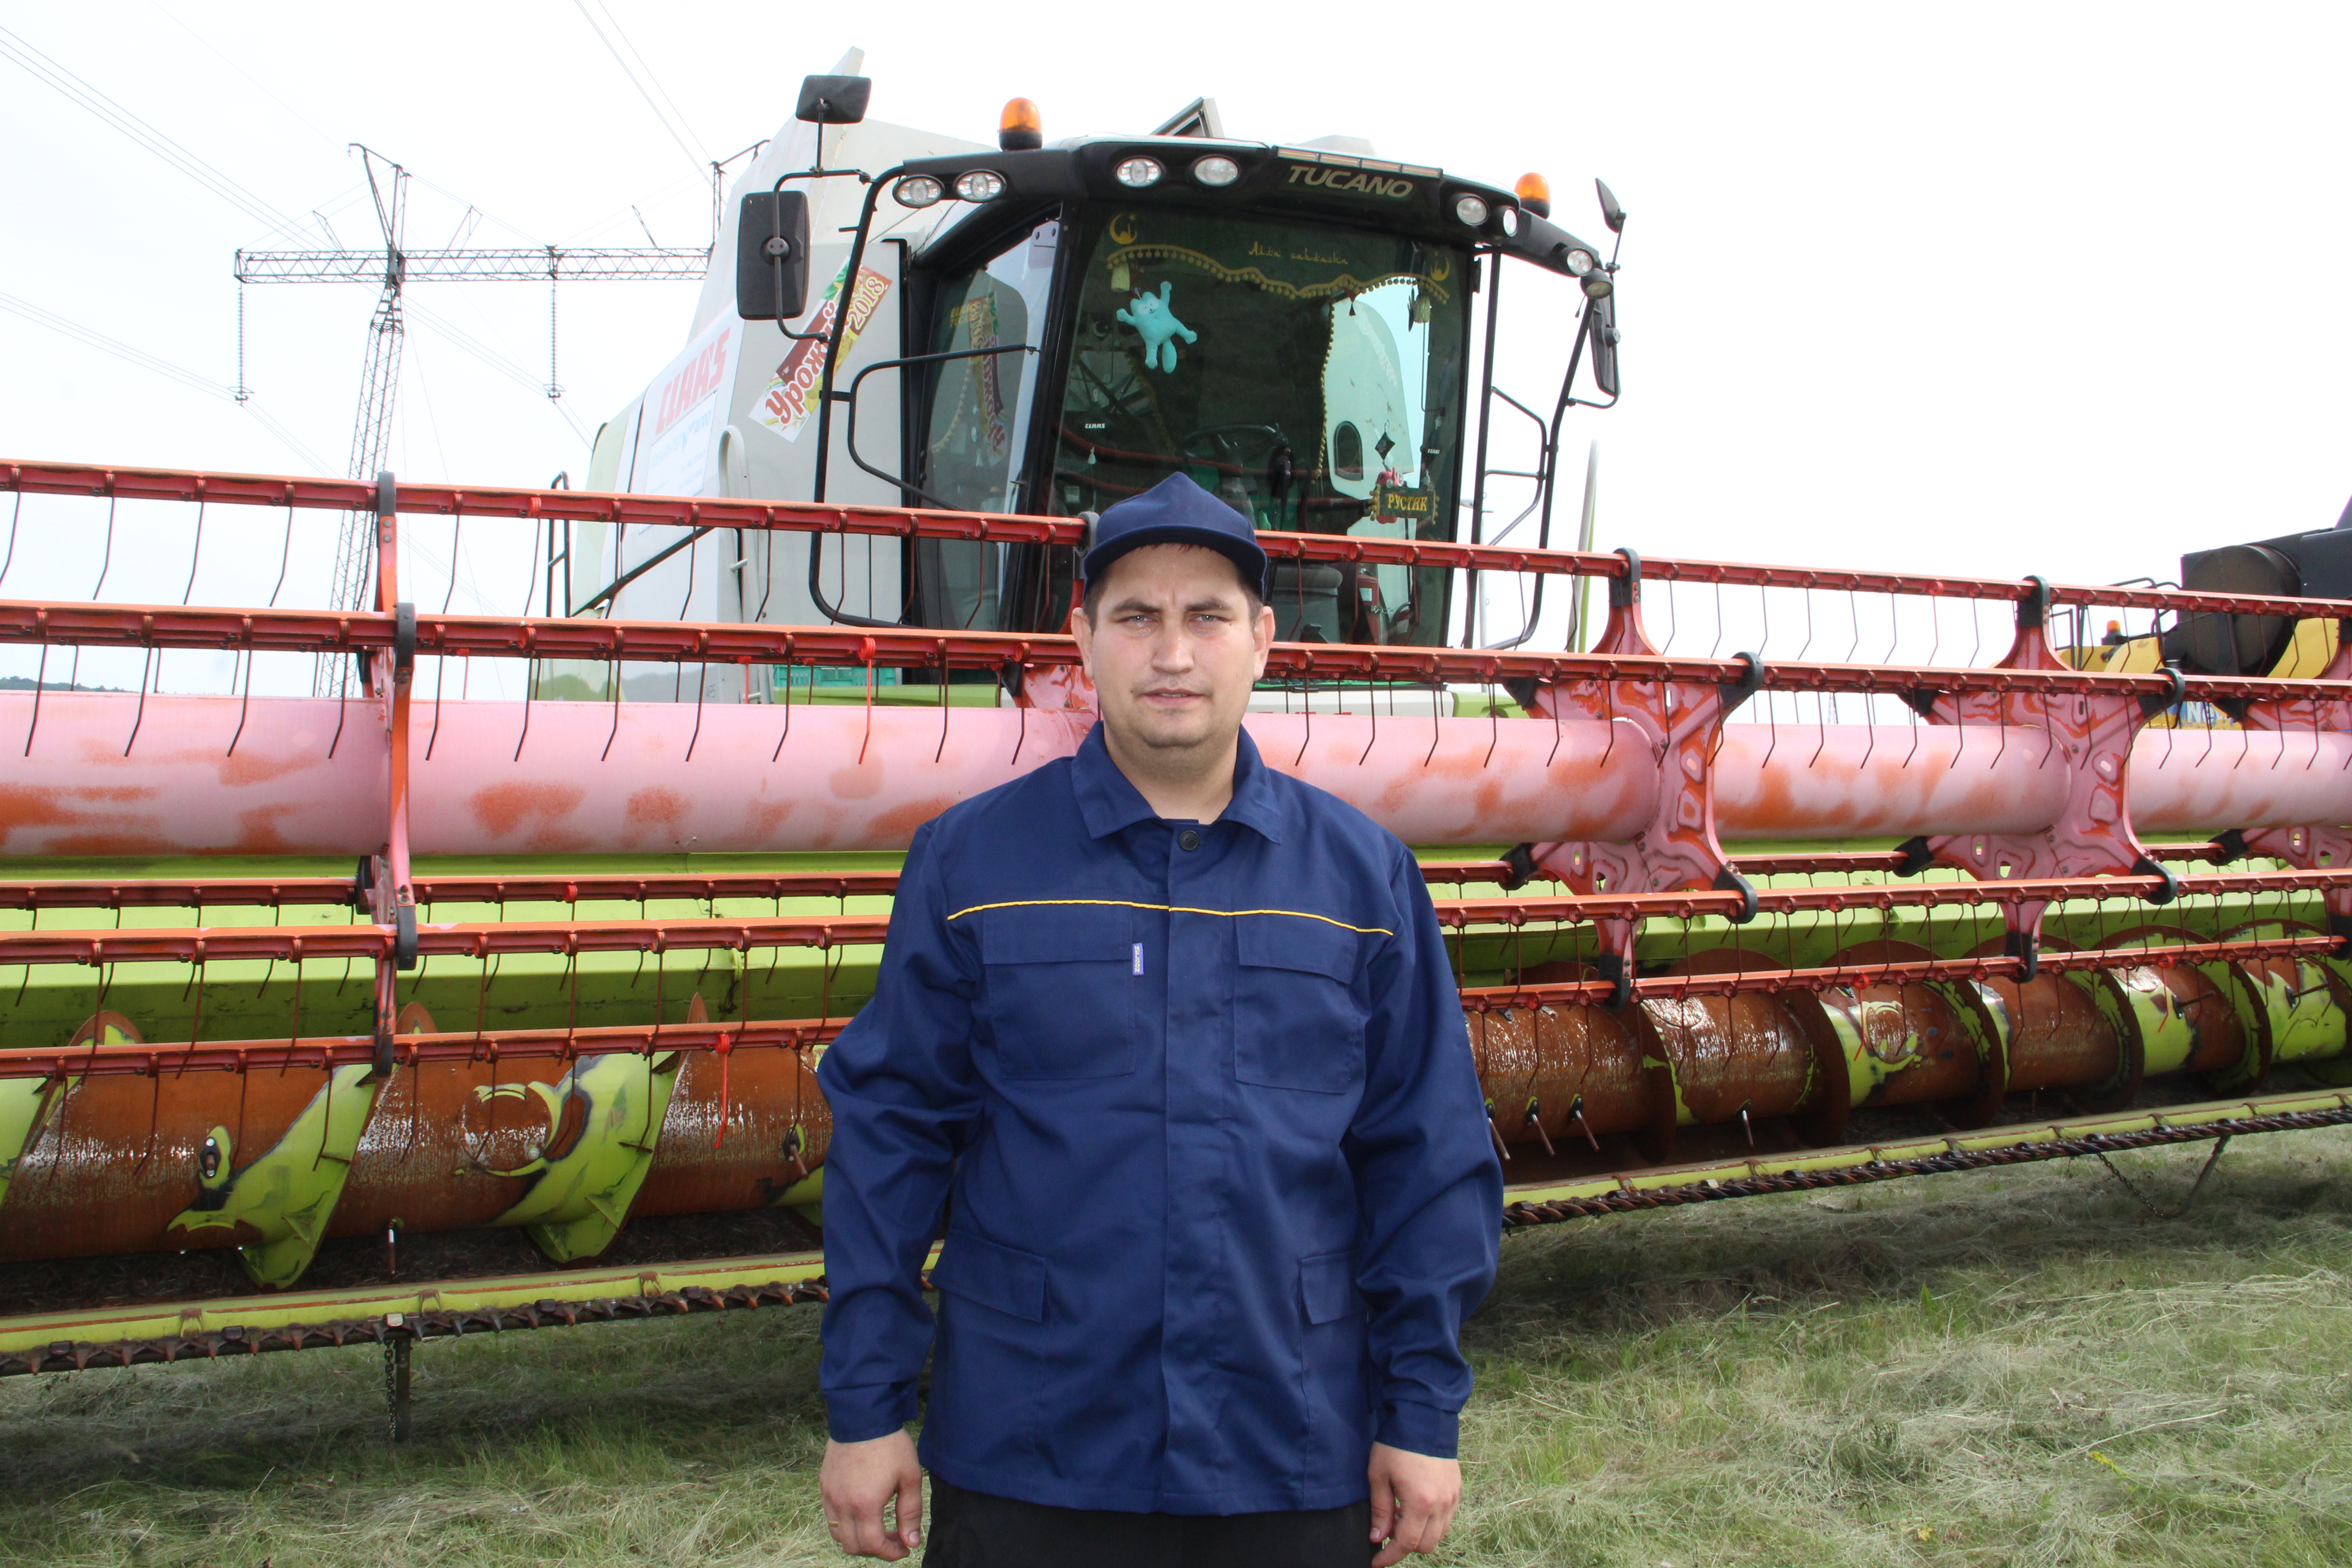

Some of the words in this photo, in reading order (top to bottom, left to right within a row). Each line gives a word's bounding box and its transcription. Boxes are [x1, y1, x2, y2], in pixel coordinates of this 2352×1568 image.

[1288, 165, 1413, 198] TUCANO
[847, 276, 886, 330] 2018
[656, 326, 731, 436] CLAAS
[765, 300, 850, 424] Урожй
[1387, 493, 1428, 511] РУСТИК
